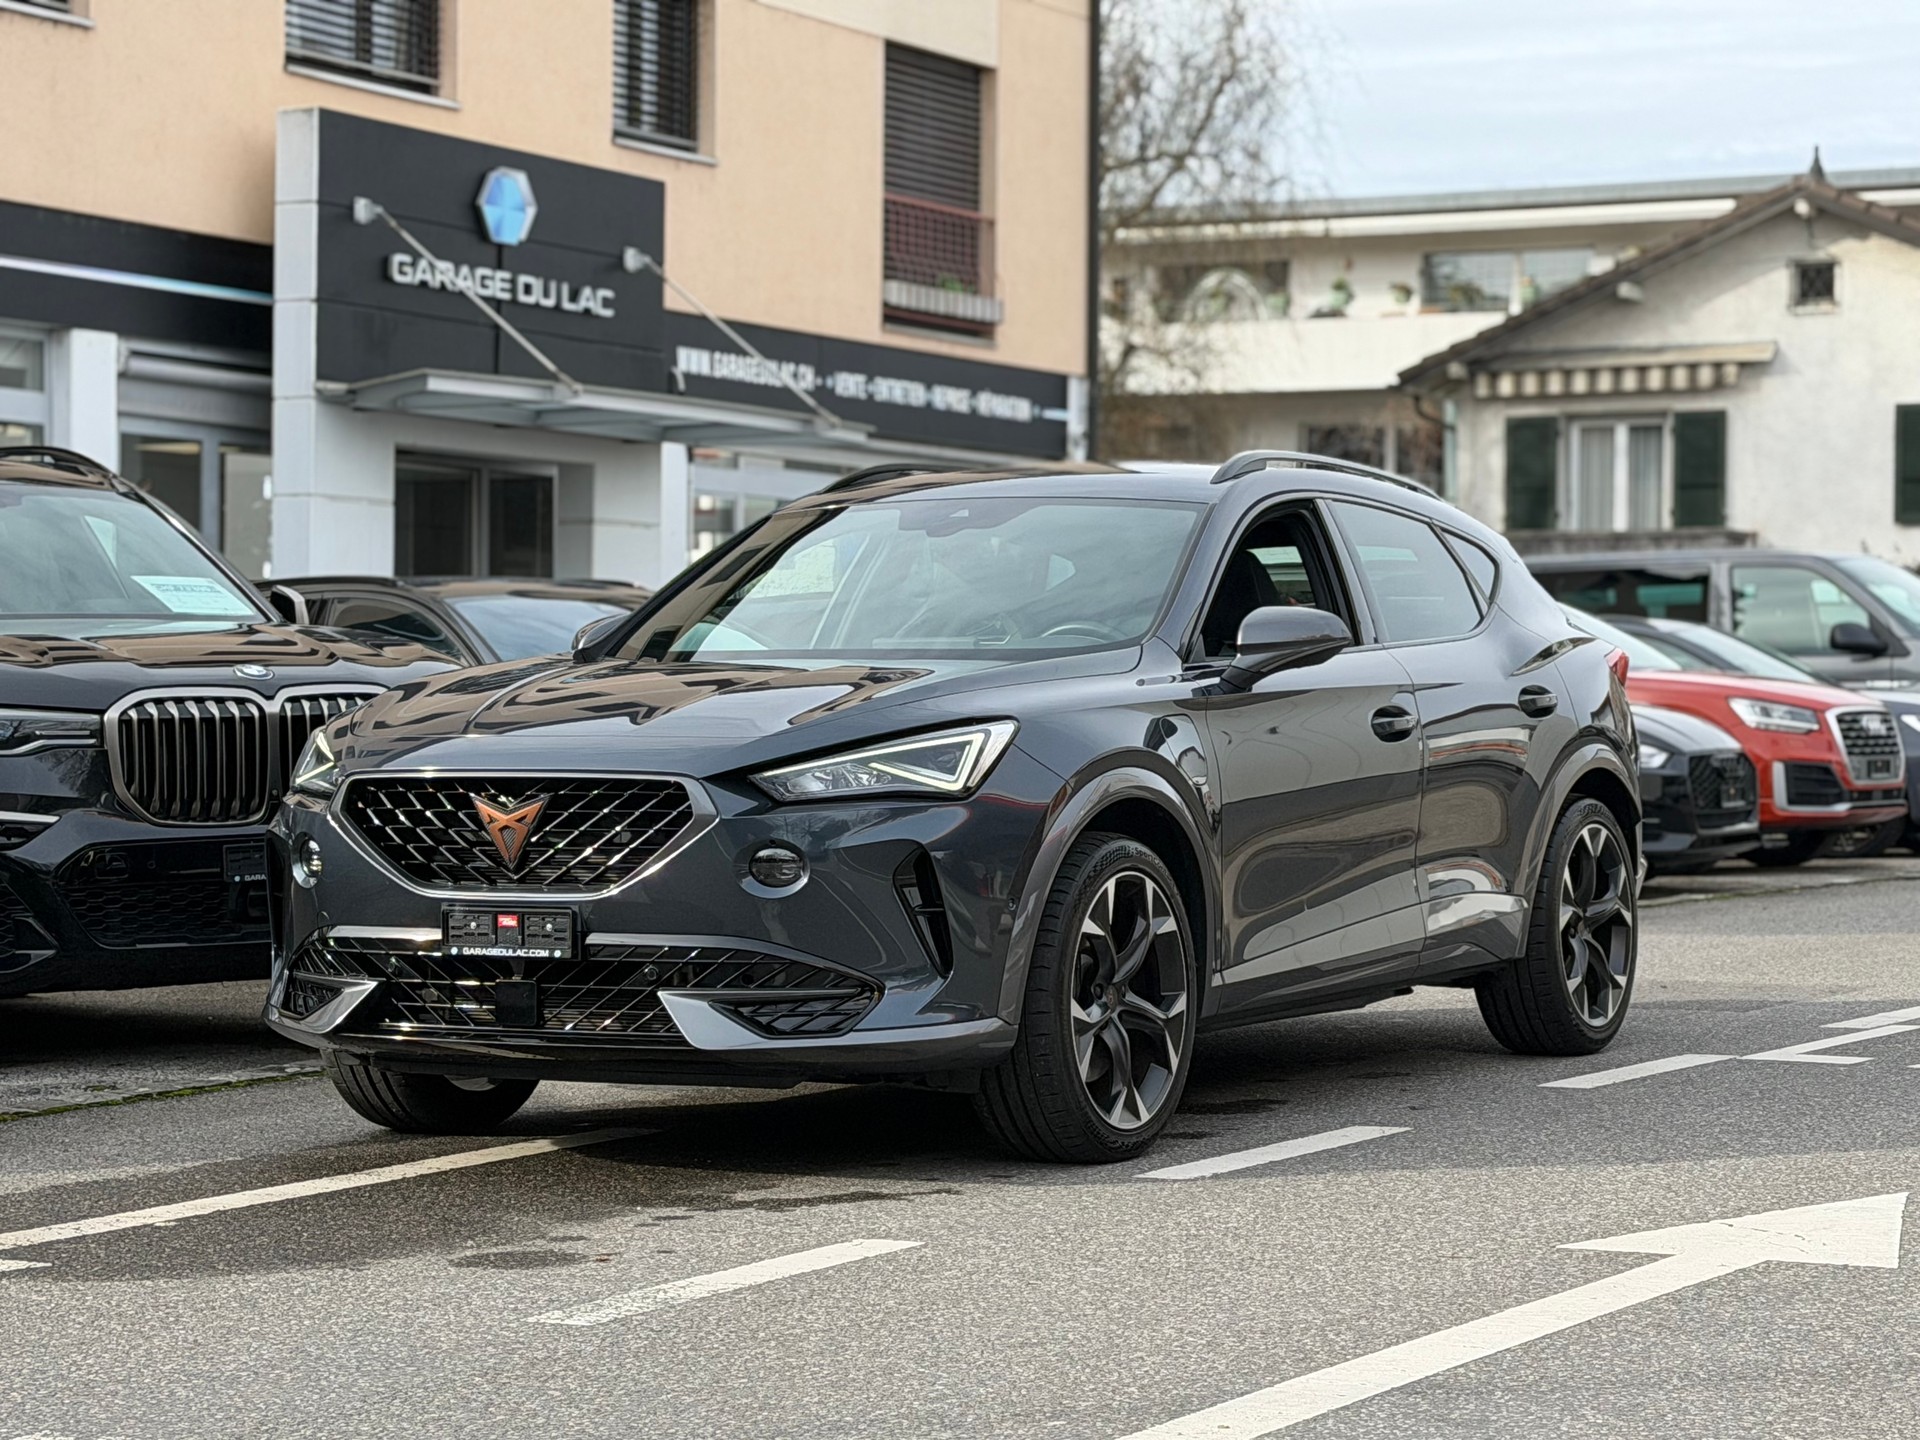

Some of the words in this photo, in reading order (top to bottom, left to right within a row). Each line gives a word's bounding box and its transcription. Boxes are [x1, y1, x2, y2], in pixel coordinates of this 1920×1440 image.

[388, 253, 512, 301] GARAGE
[517, 274, 556, 308] DU
[561, 281, 615, 318] LAC
[462, 947, 550, 958] GARAGEDULAC.COM
